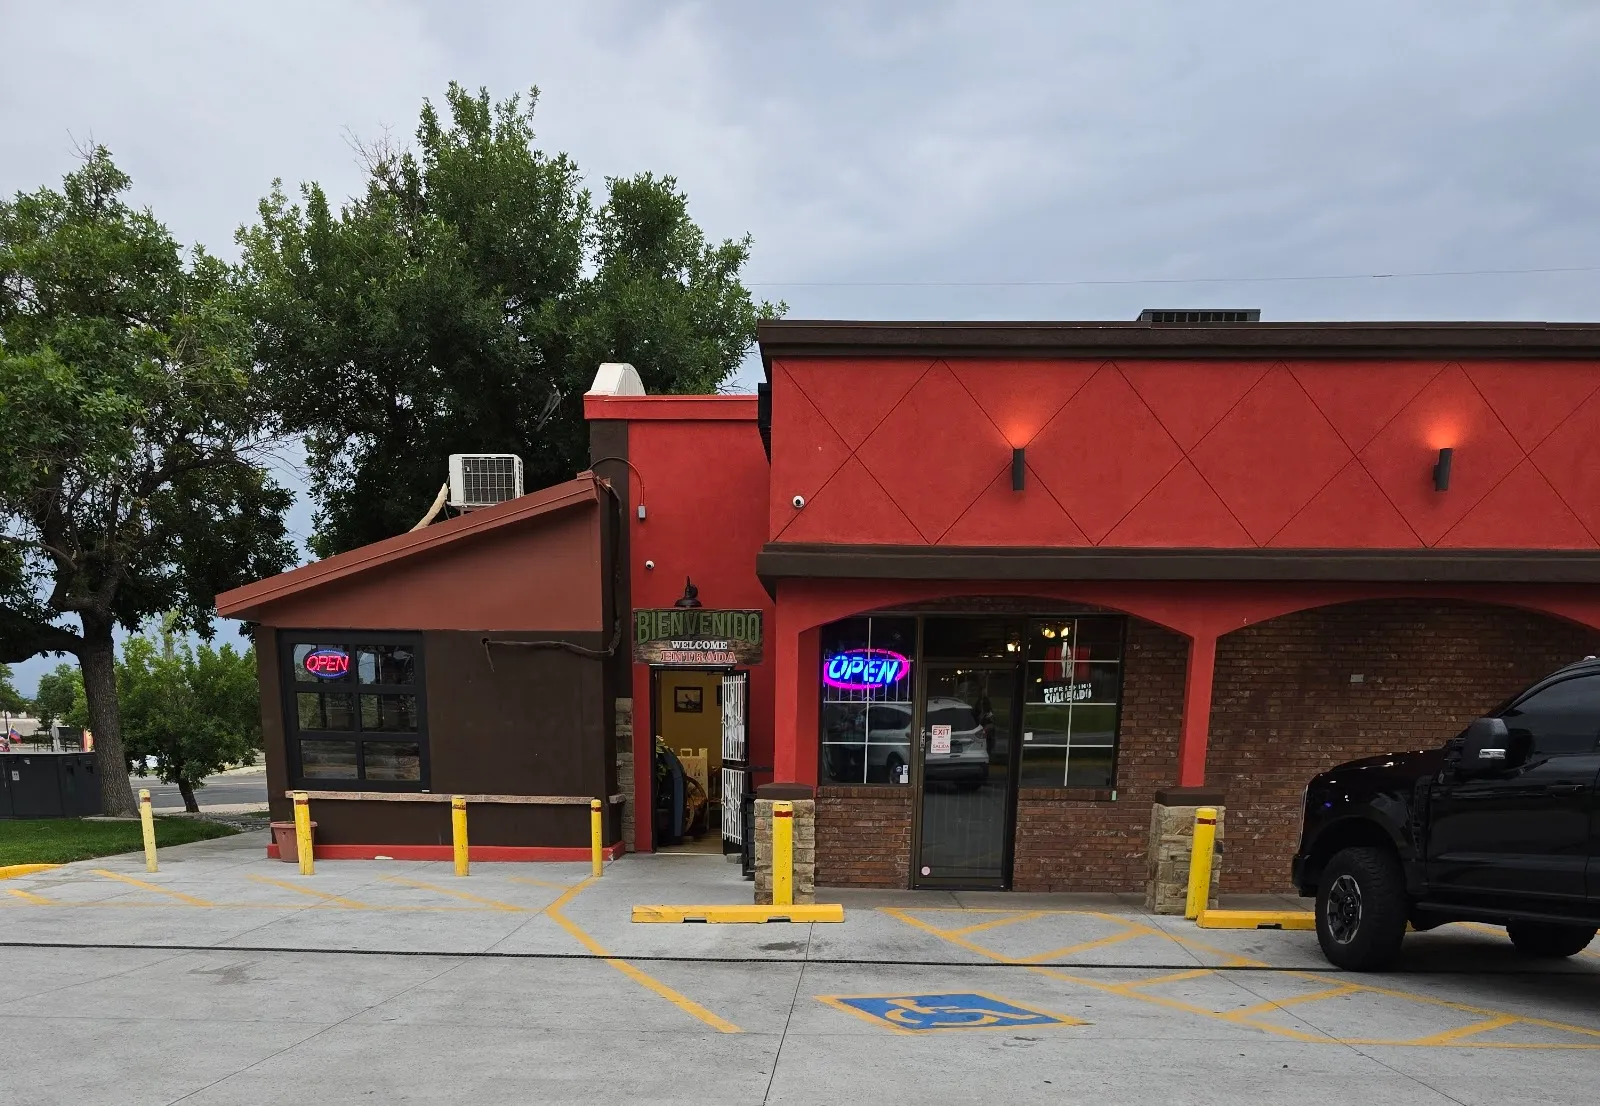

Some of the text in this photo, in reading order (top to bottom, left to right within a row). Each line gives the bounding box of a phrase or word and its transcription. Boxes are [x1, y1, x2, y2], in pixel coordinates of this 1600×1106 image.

[636, 611, 760, 646] BIENVENIDO
[671, 640, 728, 650] WELCOME
[306, 655, 349, 671] OPEN
[660, 650, 737, 664] ENTRADA
[828, 655, 899, 684] OPEN
[932, 728, 950, 736] EXIT
